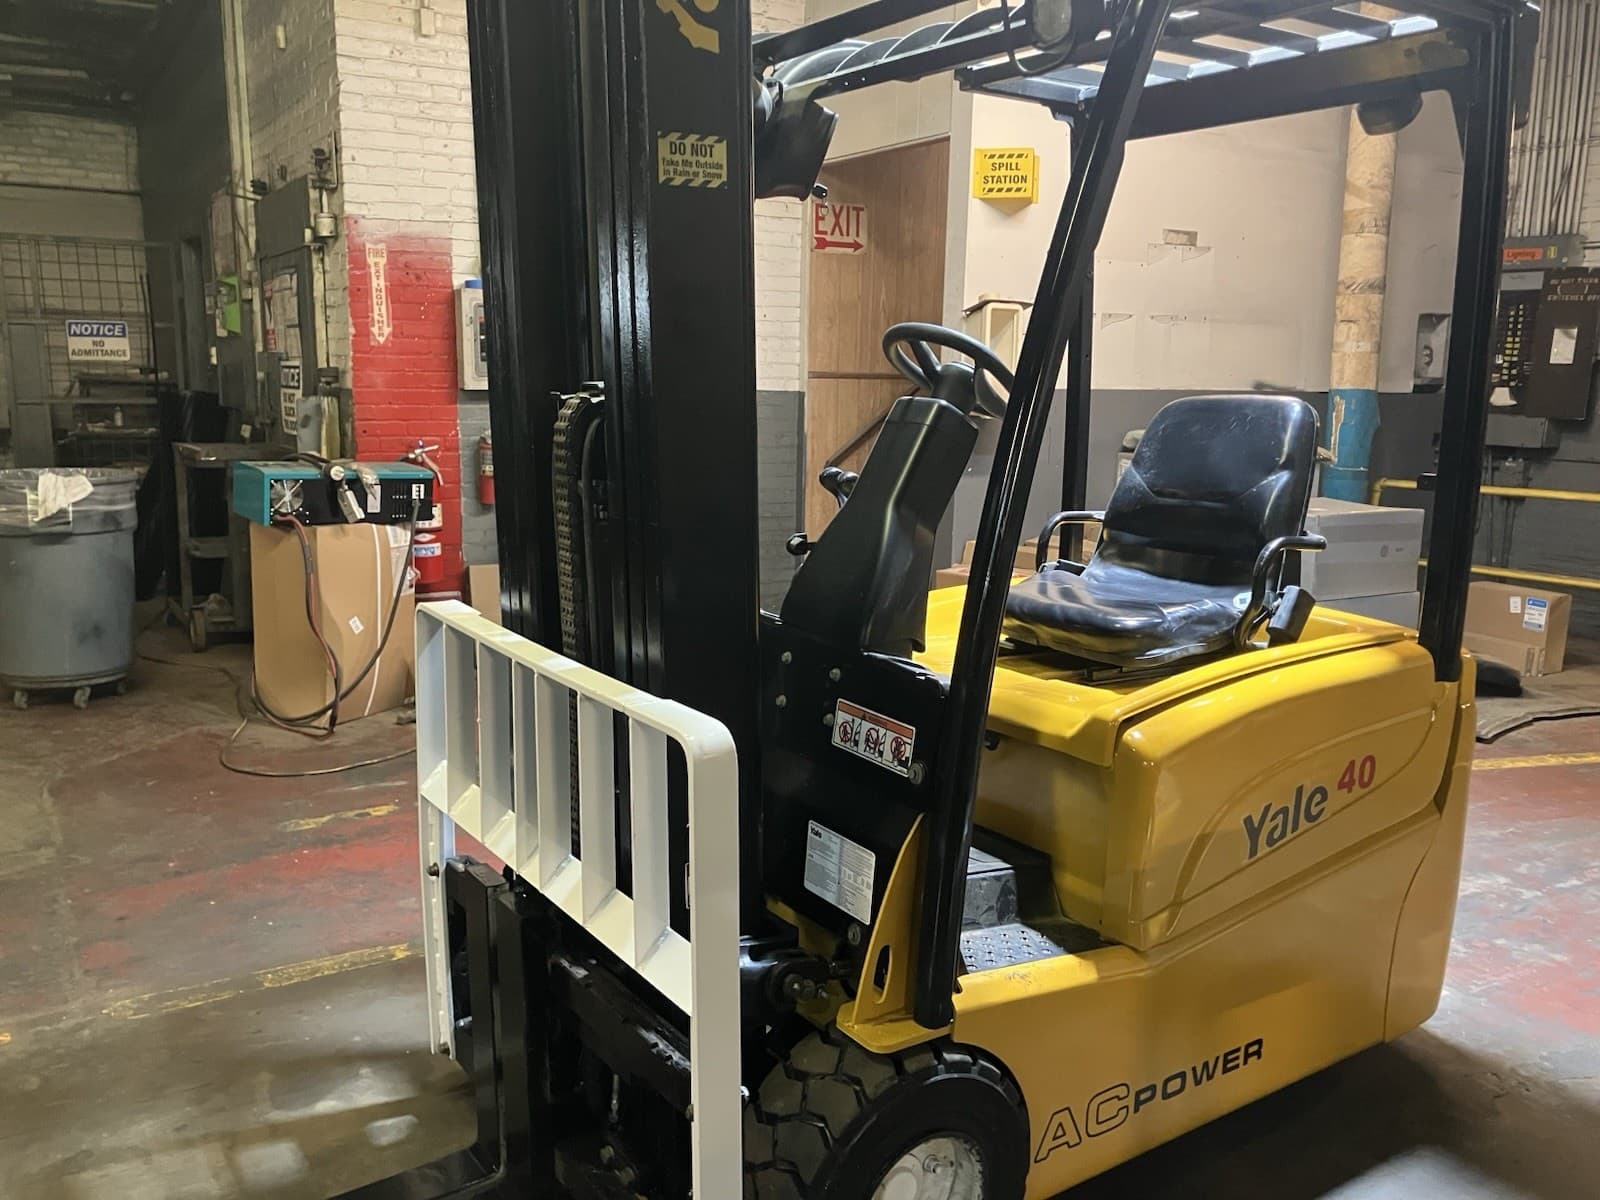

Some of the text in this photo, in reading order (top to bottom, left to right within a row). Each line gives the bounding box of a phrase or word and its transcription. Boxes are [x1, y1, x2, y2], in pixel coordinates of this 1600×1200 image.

[670, 141, 714, 158] DO NOT
[662, 158, 680, 168] Take
[695, 160, 724, 171] Outside
[991, 162, 1021, 171] SPILL
[673, 168, 691, 177] Rain
[702, 170, 723, 180] Snow
[983, 175, 1028, 184] STATION
[815, 203, 865, 238] EXIT
[367, 248, 386, 258] FIRE
[374, 262, 385, 338] EXTINGUISHER
[70, 323, 124, 336] NOTICE
[92, 340, 105, 348] NO
[71, 348, 129, 358] ADMITTANCE
[1242, 754, 1377, 860] Yale 40
[1133, 1038, 1264, 1115] POWER
